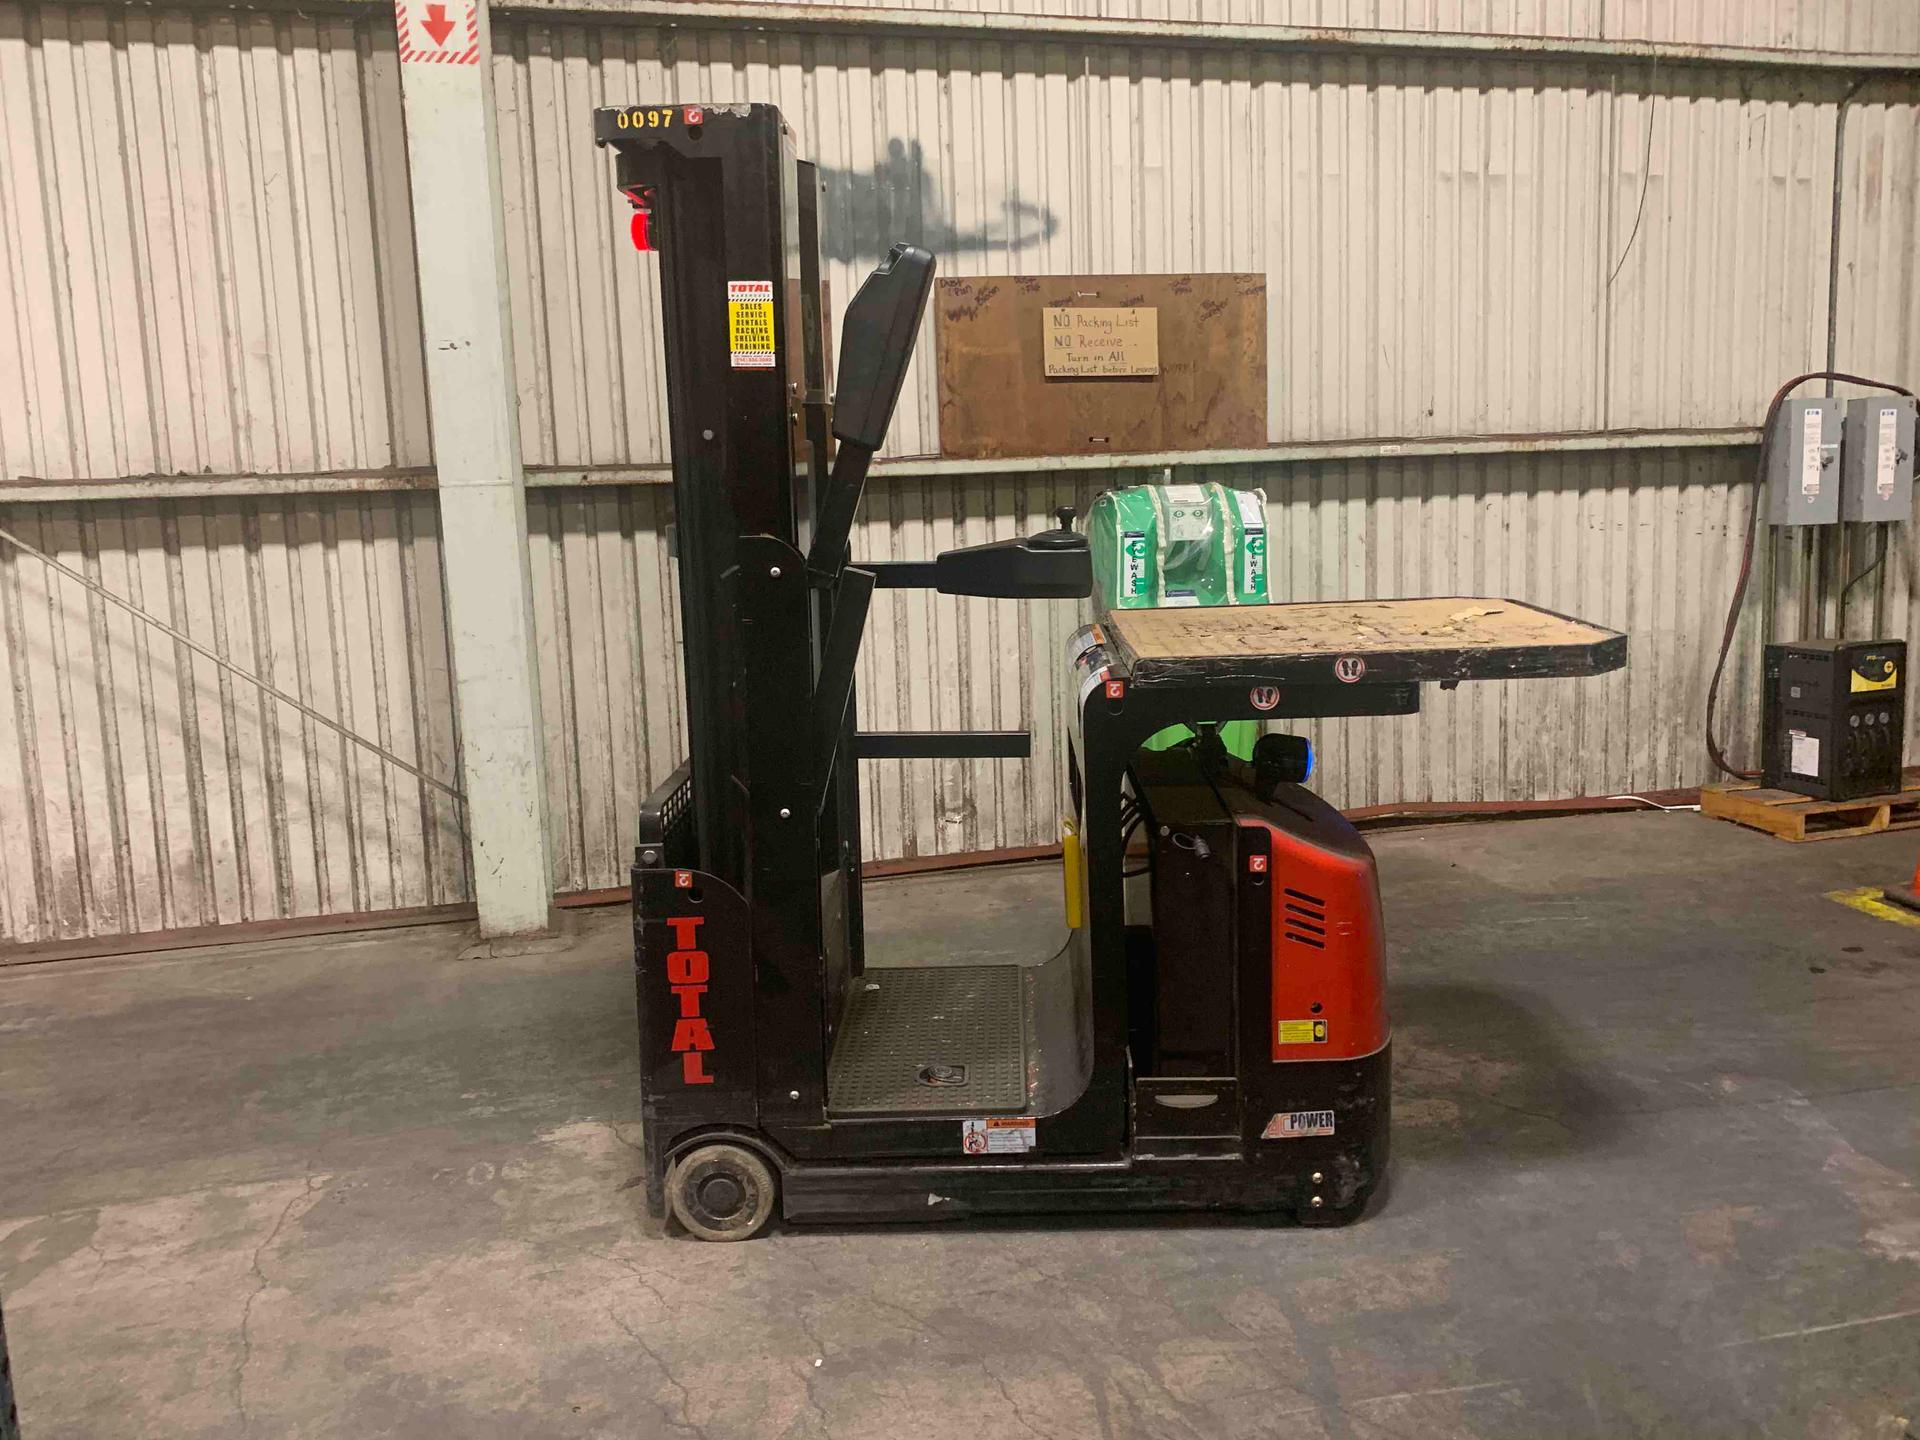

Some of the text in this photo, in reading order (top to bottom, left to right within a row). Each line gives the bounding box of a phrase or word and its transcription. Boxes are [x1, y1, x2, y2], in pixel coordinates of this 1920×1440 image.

[617, 109, 673, 128] 0097
[1053, 314, 1140, 334] NO Packing List
[1054, 335, 1072, 348] NO
[1067, 352, 1089, 362] Turn
[1108, 351, 1125, 362] All
[1048, 363, 1079, 375] Packing
[1081, 364, 1098, 374] List
[667, 916, 715, 1084] TOTAL
[1290, 1111, 1333, 1130] POWER
